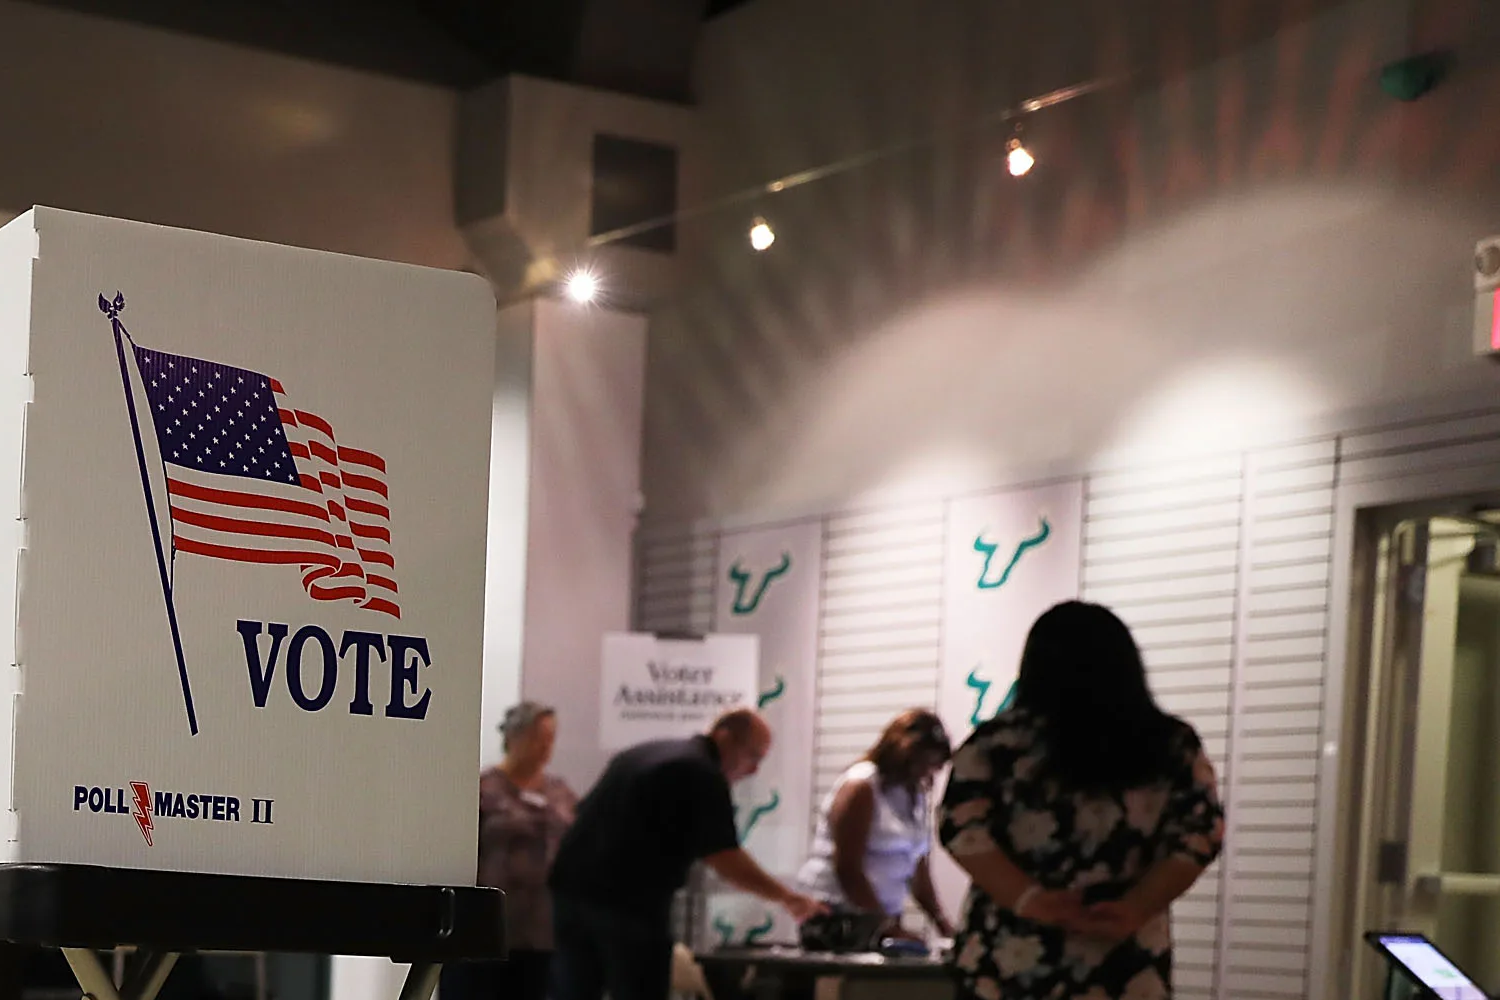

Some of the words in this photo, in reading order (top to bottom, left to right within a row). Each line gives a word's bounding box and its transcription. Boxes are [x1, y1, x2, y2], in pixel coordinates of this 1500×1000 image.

[236, 619, 433, 721] VOTE
[646, 661, 713, 684] Voter
[73, 784, 130, 815] POLL
[153, 791, 241, 822] MASTER
[250, 798, 275, 825] II
